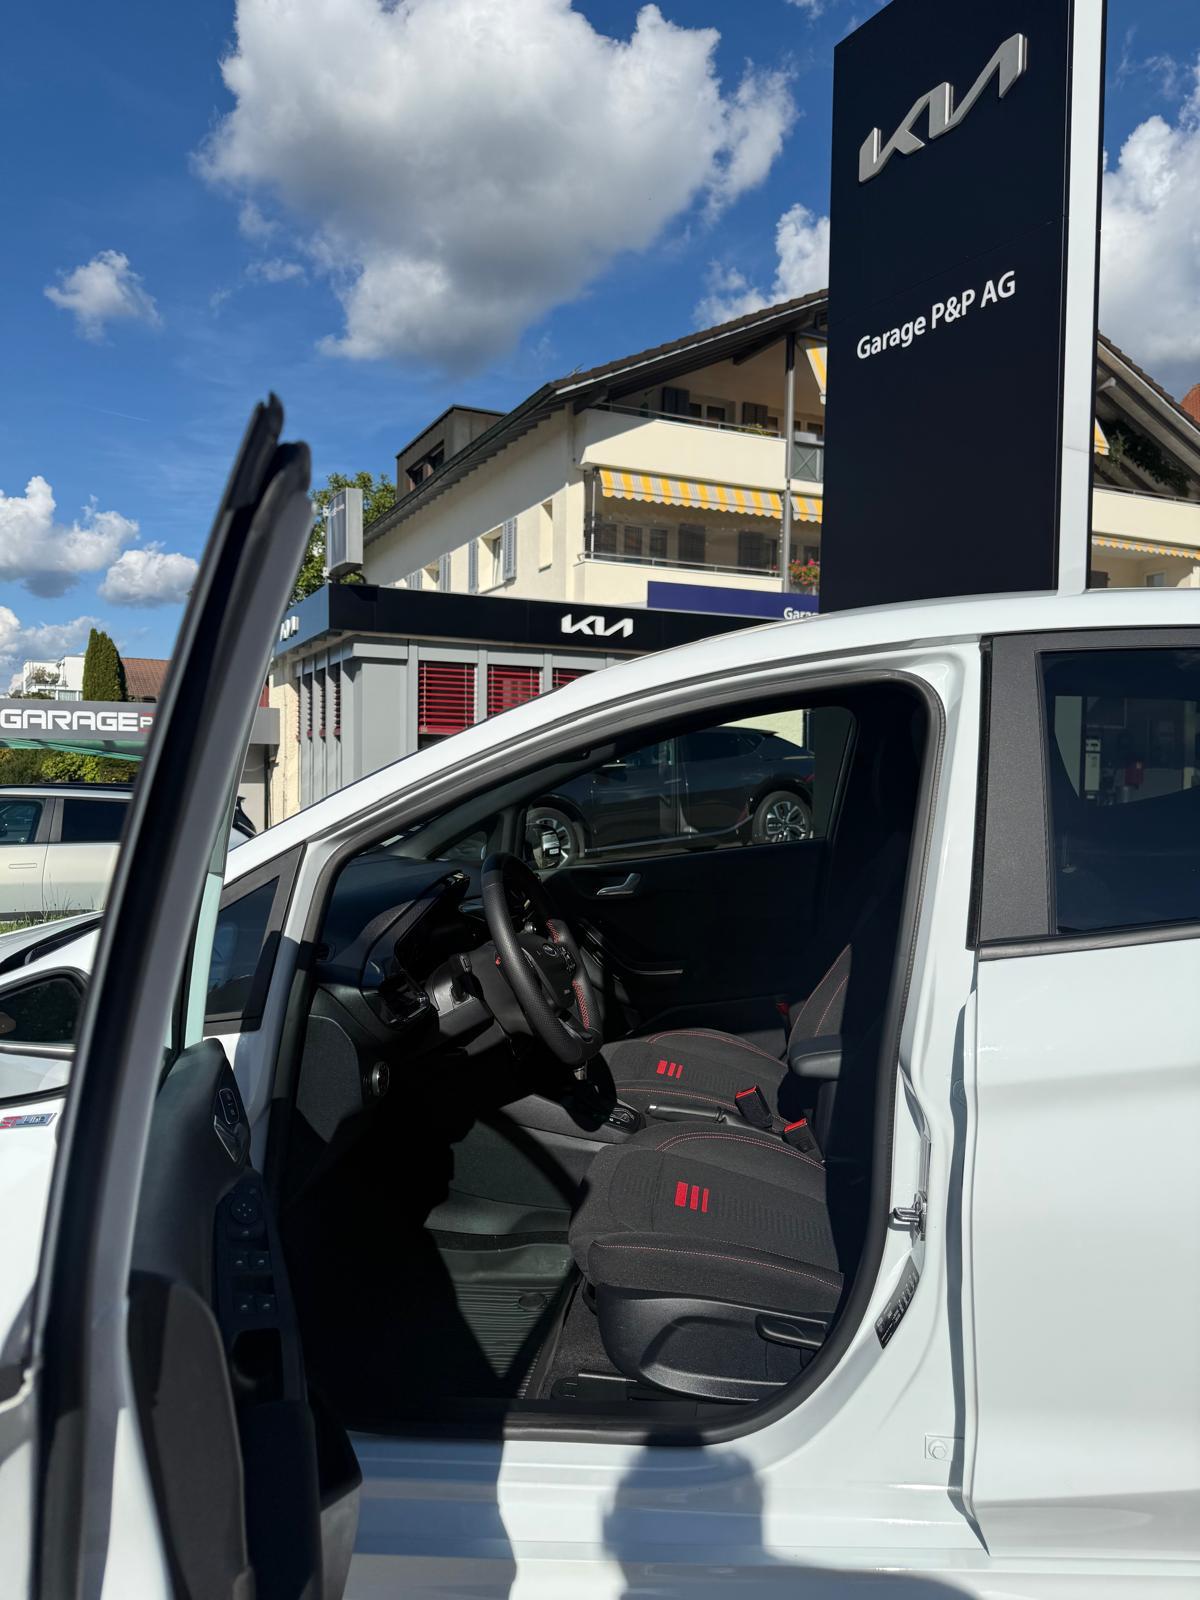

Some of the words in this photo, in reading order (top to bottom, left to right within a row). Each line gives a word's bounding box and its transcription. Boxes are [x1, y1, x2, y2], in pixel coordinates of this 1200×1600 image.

[856, 315, 927, 359] Garage
[931, 288, 976, 329] P&P
[980, 270, 1016, 308] AG
[560, 613, 634, 638] KIA
[0, 708, 139, 732] GARAGE
